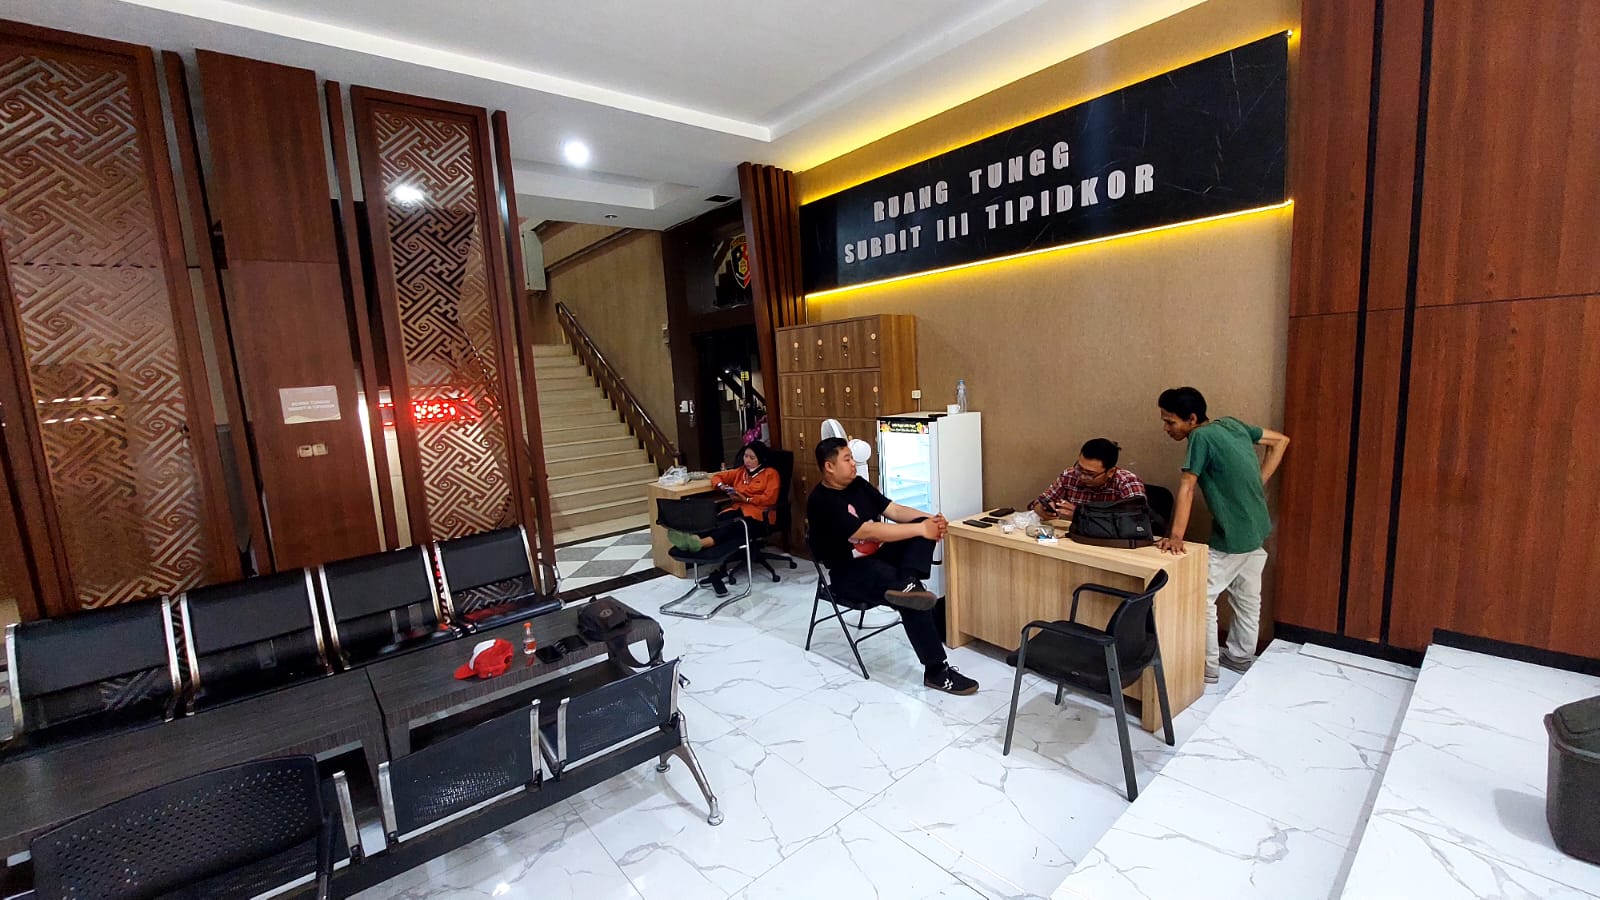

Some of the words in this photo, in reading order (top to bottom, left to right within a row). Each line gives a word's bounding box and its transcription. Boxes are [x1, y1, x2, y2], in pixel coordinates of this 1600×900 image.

[844, 225, 922, 264] SUBDIT
[936, 212, 969, 242] III
[985, 163, 1155, 229] TIPIDKOR
[873, 181, 949, 222] RUANG
[969, 141, 1070, 194] TUNGG
